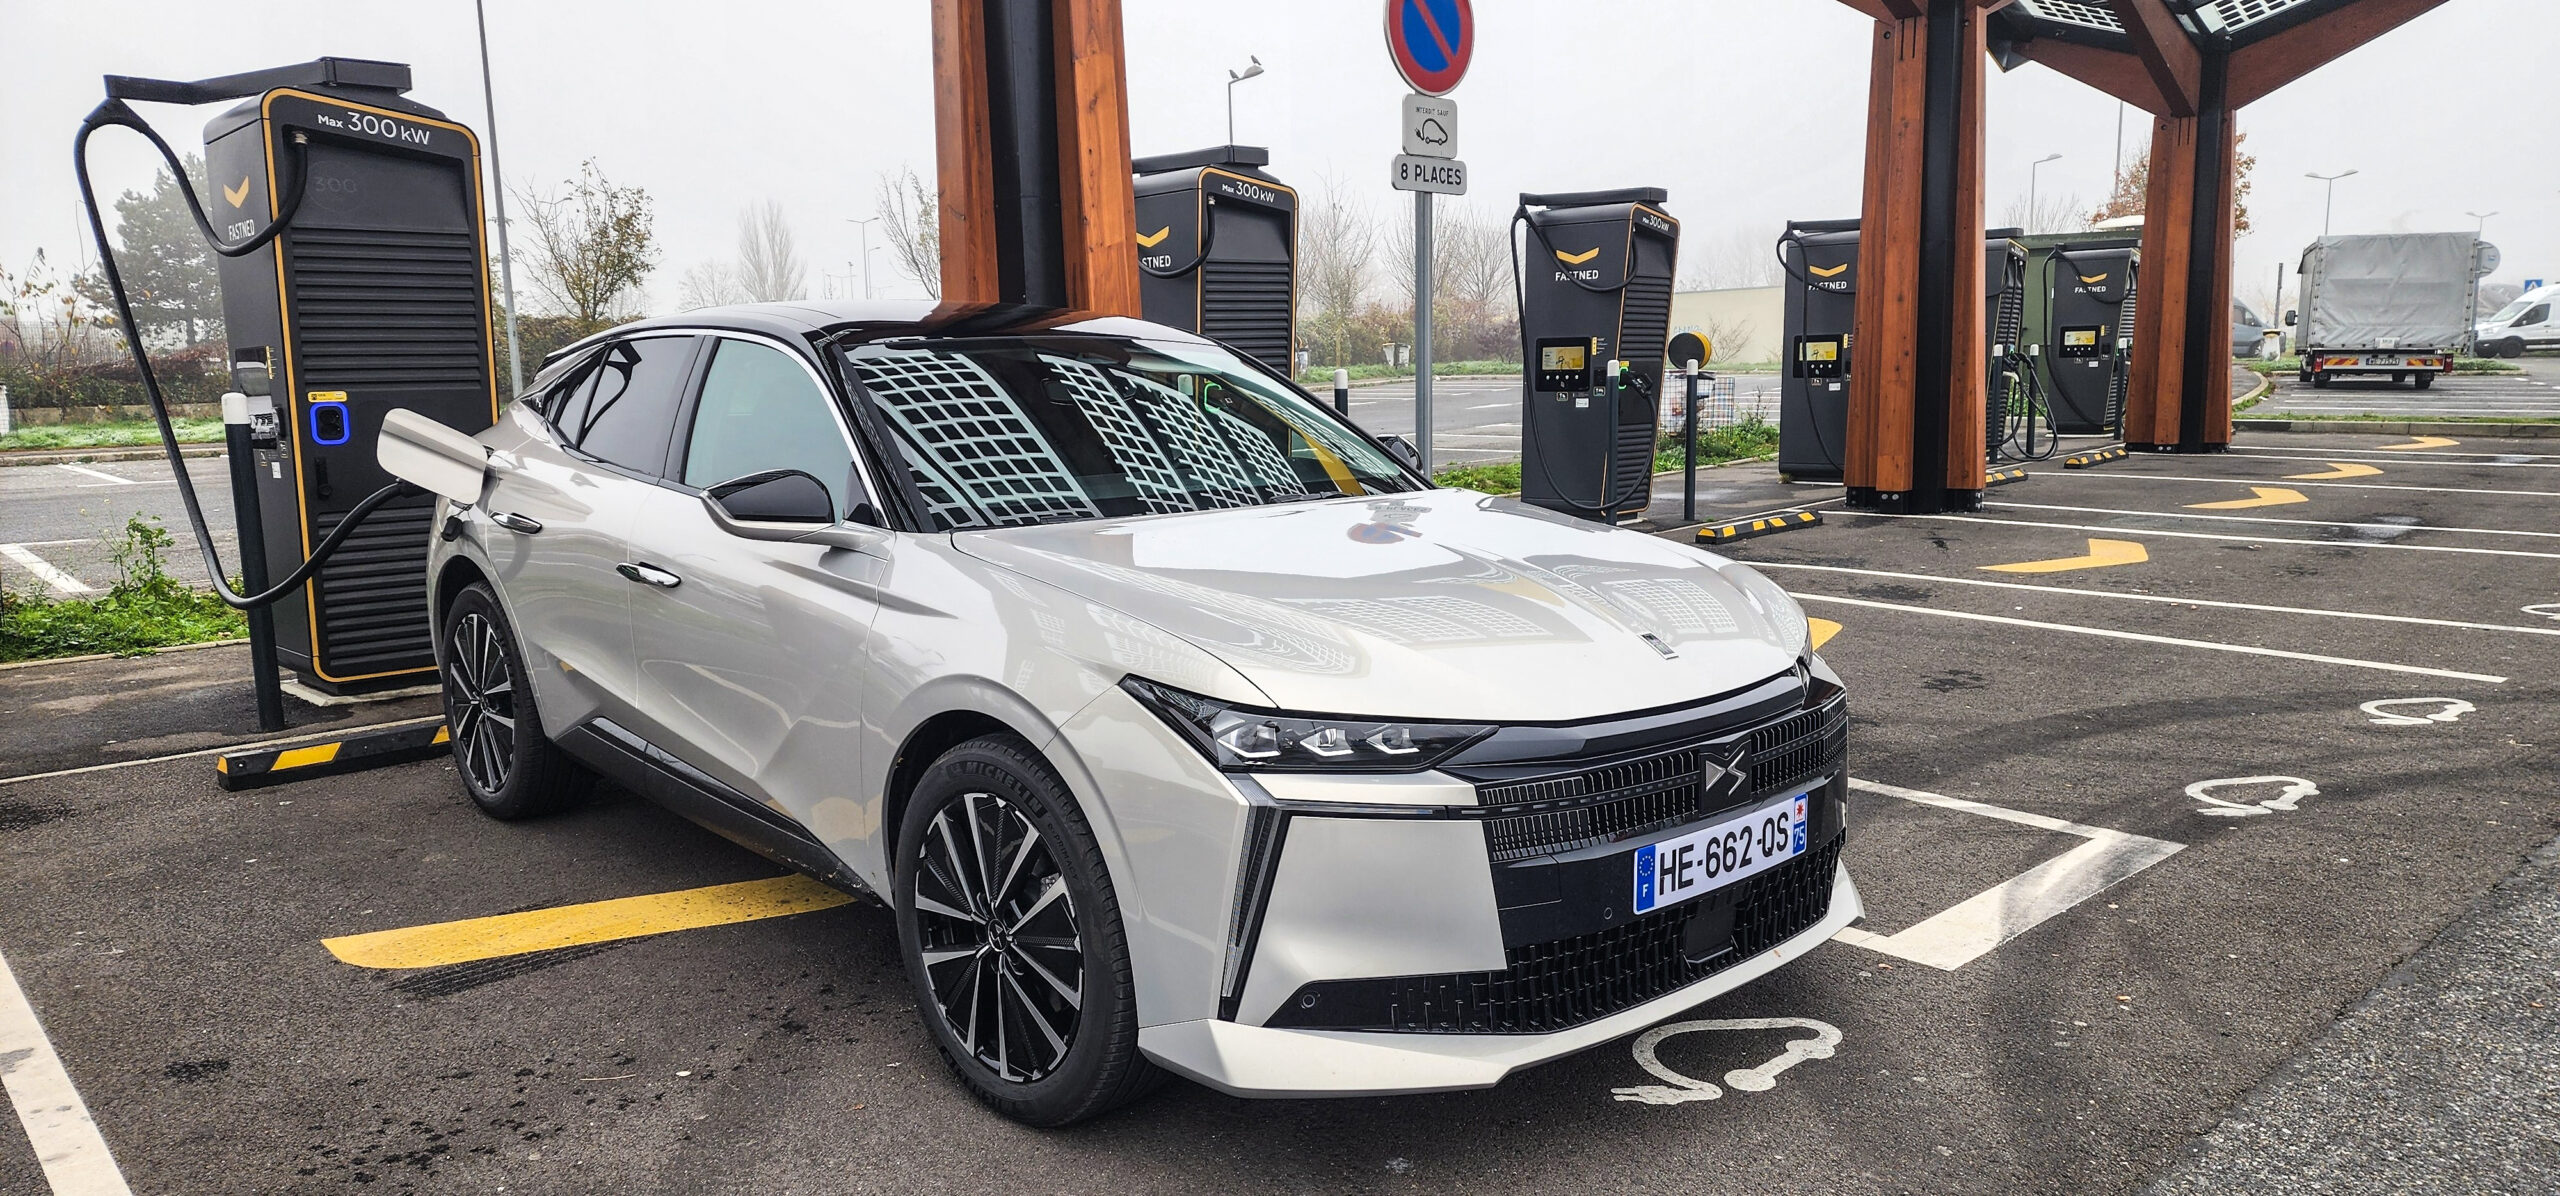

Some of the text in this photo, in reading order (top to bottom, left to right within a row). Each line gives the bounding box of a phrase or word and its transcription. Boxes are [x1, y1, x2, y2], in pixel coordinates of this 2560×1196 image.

[317, 111, 430, 145] Max 300 kW
[1400, 162, 1462, 186] 8 PLACES
[1221, 181, 1275, 203] Max 300 kW
[228, 219, 255, 241] FASTNED
[1649, 214, 1662, 229] 300
[1142, 255, 1172, 269] STNED
[966, 761, 1043, 813] MICHELIN
[1793, 825, 1805, 848] 75
[1659, 811, 1790, 896] HE-662-QS
[1642, 883, 1649, 898] F
